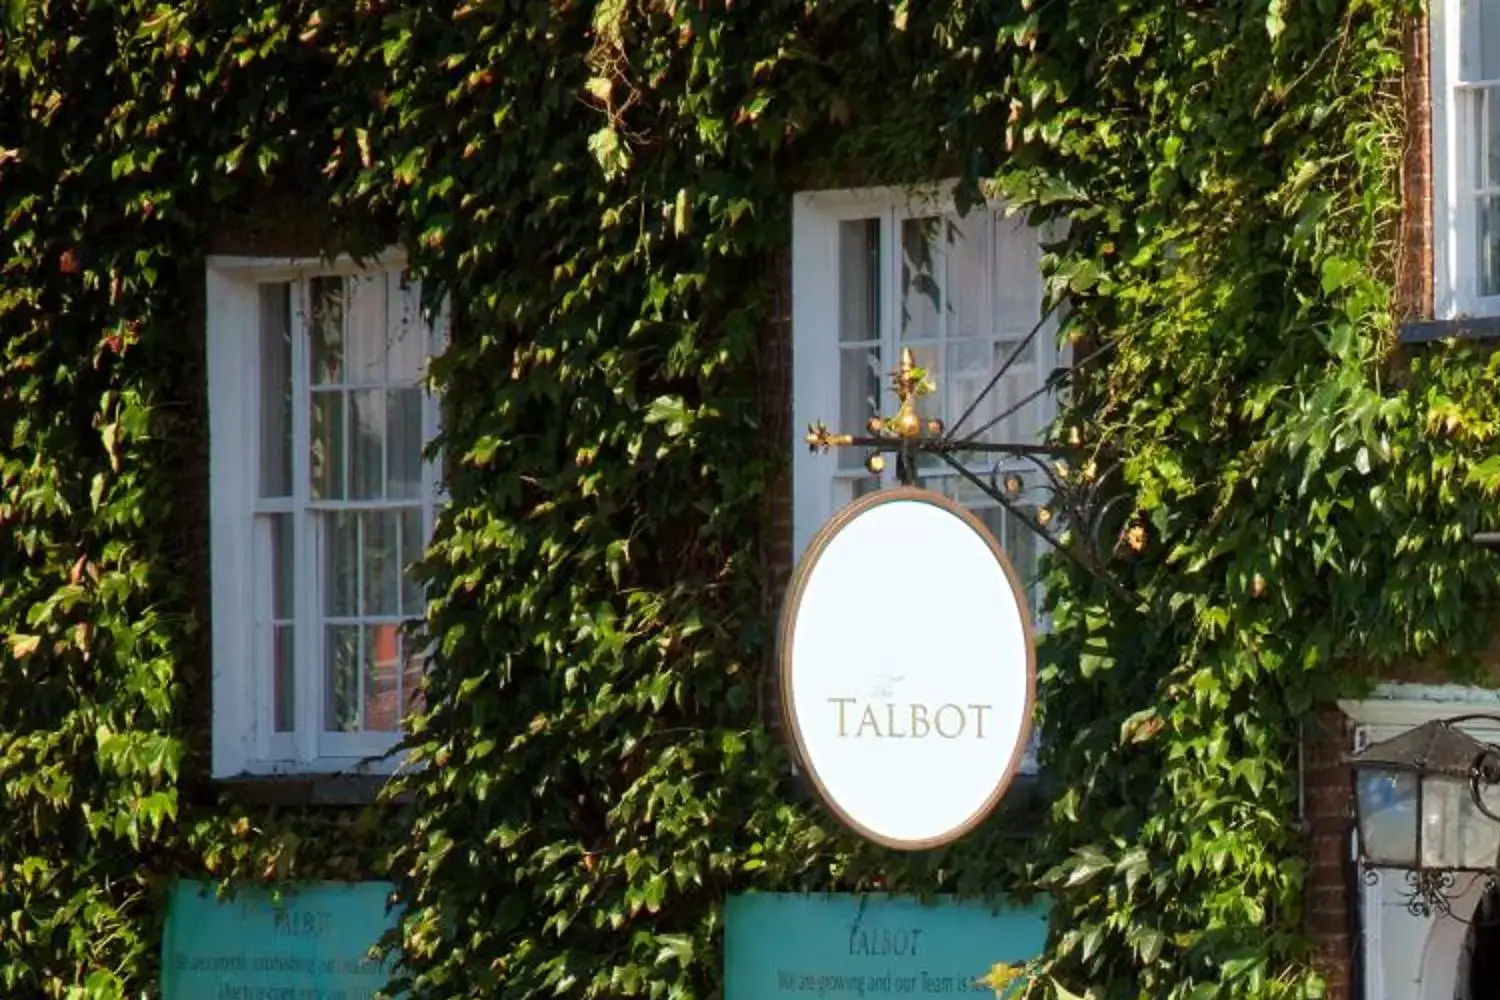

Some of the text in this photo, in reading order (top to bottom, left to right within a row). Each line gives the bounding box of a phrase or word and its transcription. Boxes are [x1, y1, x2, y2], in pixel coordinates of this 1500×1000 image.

[827, 697, 992, 738] TALBOT
[849, 927, 923, 957] TALBOT
[777, 969, 796, 991] We
[817, 974, 865, 998] growing
[867, 969, 891, 992] and
[894, 975, 917, 993] our
[920, 971, 953, 994] Team
[957, 972, 967, 993] is
